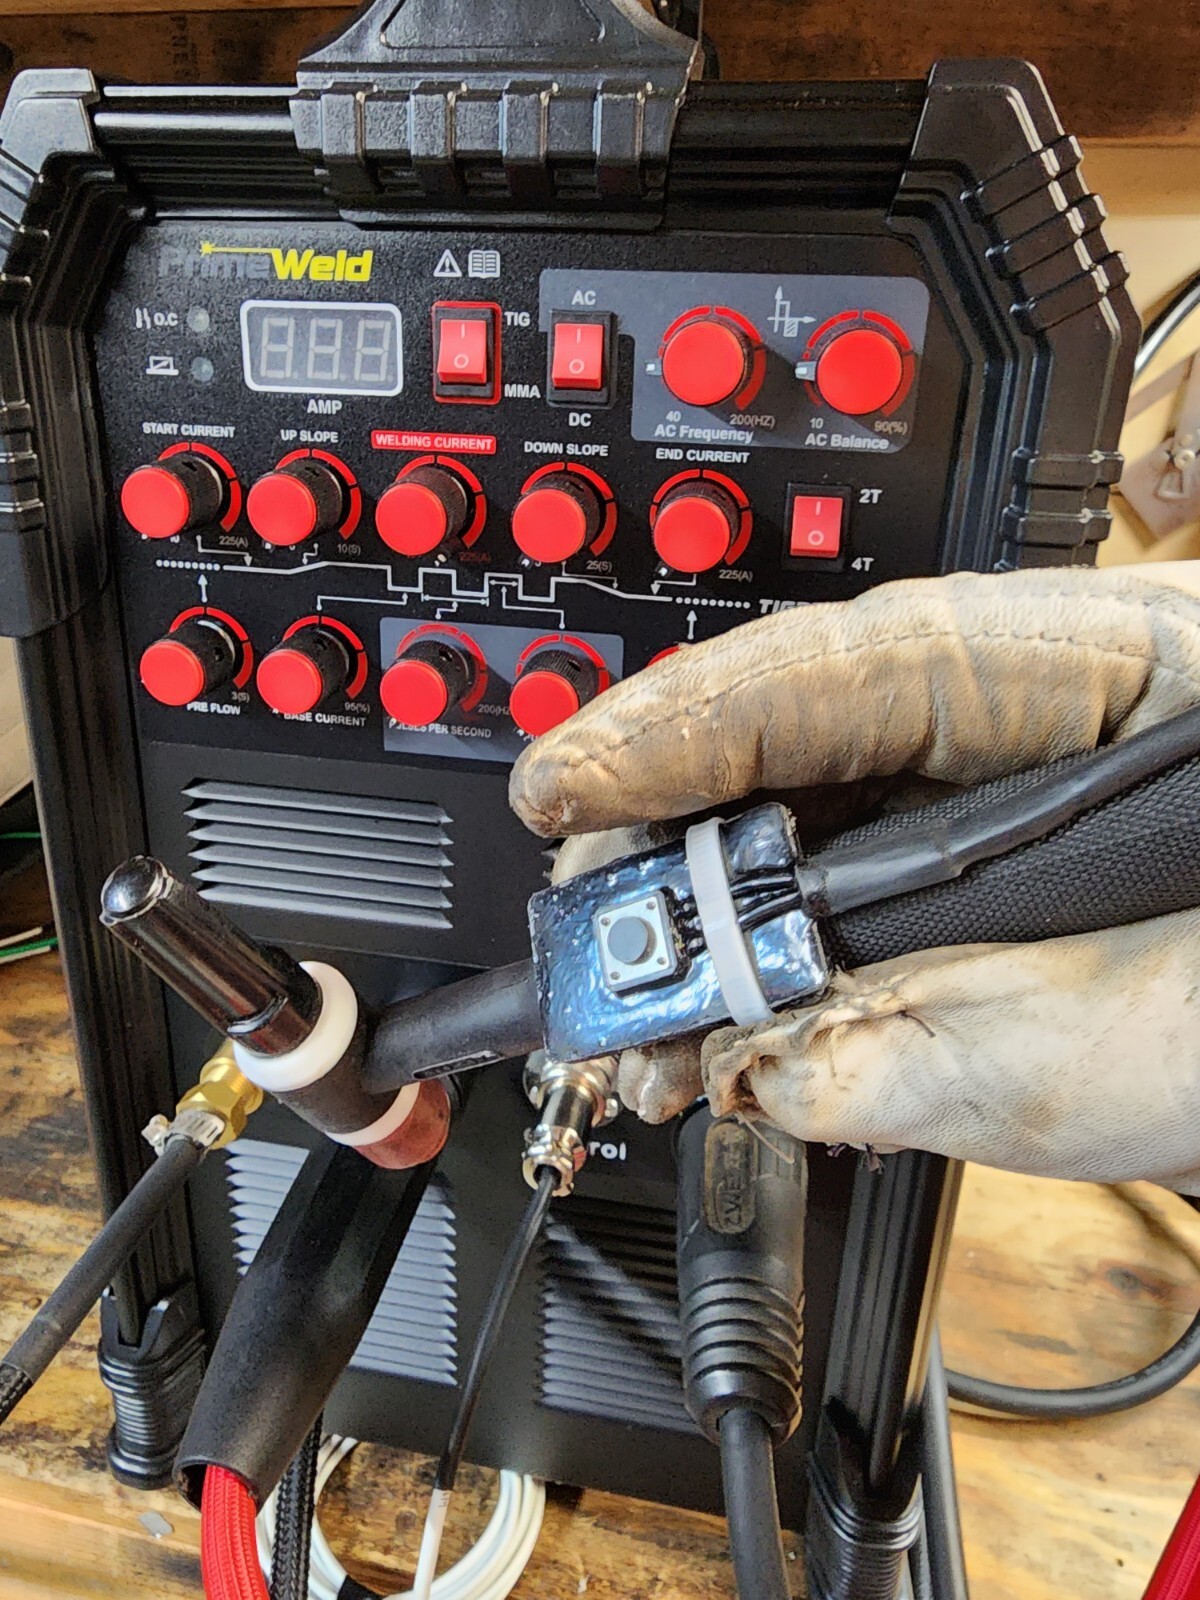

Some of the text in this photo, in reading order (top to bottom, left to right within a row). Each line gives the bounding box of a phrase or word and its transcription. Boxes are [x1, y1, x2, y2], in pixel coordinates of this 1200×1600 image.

[571, 290, 597, 305] AC
[504, 311, 531, 327] TIG
[504, 383, 541, 399] MMA
[306, 399, 342, 414] AMP
[568, 412, 592, 427] DC
[665, 410, 682, 422] 40
[729, 413, 776, 429] 200(HZ)
[809, 418, 824, 429] 10
[142, 422, 235, 438] START CURRENT
[280, 429, 339, 443] UP SLOPE
[654, 424, 754, 444] AC Frequency
[375, 433, 493, 451] WELDING CURRENT
[523, 441, 609, 456] DOWN SLOPE
[804, 433, 889, 449] AC Balance
[655, 447, 750, 463] END CURRENT
[859, 488, 883, 503] 2T
[219, 535, 249, 548] 225(A)
[586, 560, 613, 573] 25(S)
[851, 557, 875, 571] 4T
[718, 569, 753, 582] 225(A)
[187, 701, 241, 715] PRE FLOW
[283, 712, 367, 727] BASE CURRENT
[428, 723, 448, 734] PER
[450, 726, 492, 738] SECOND
